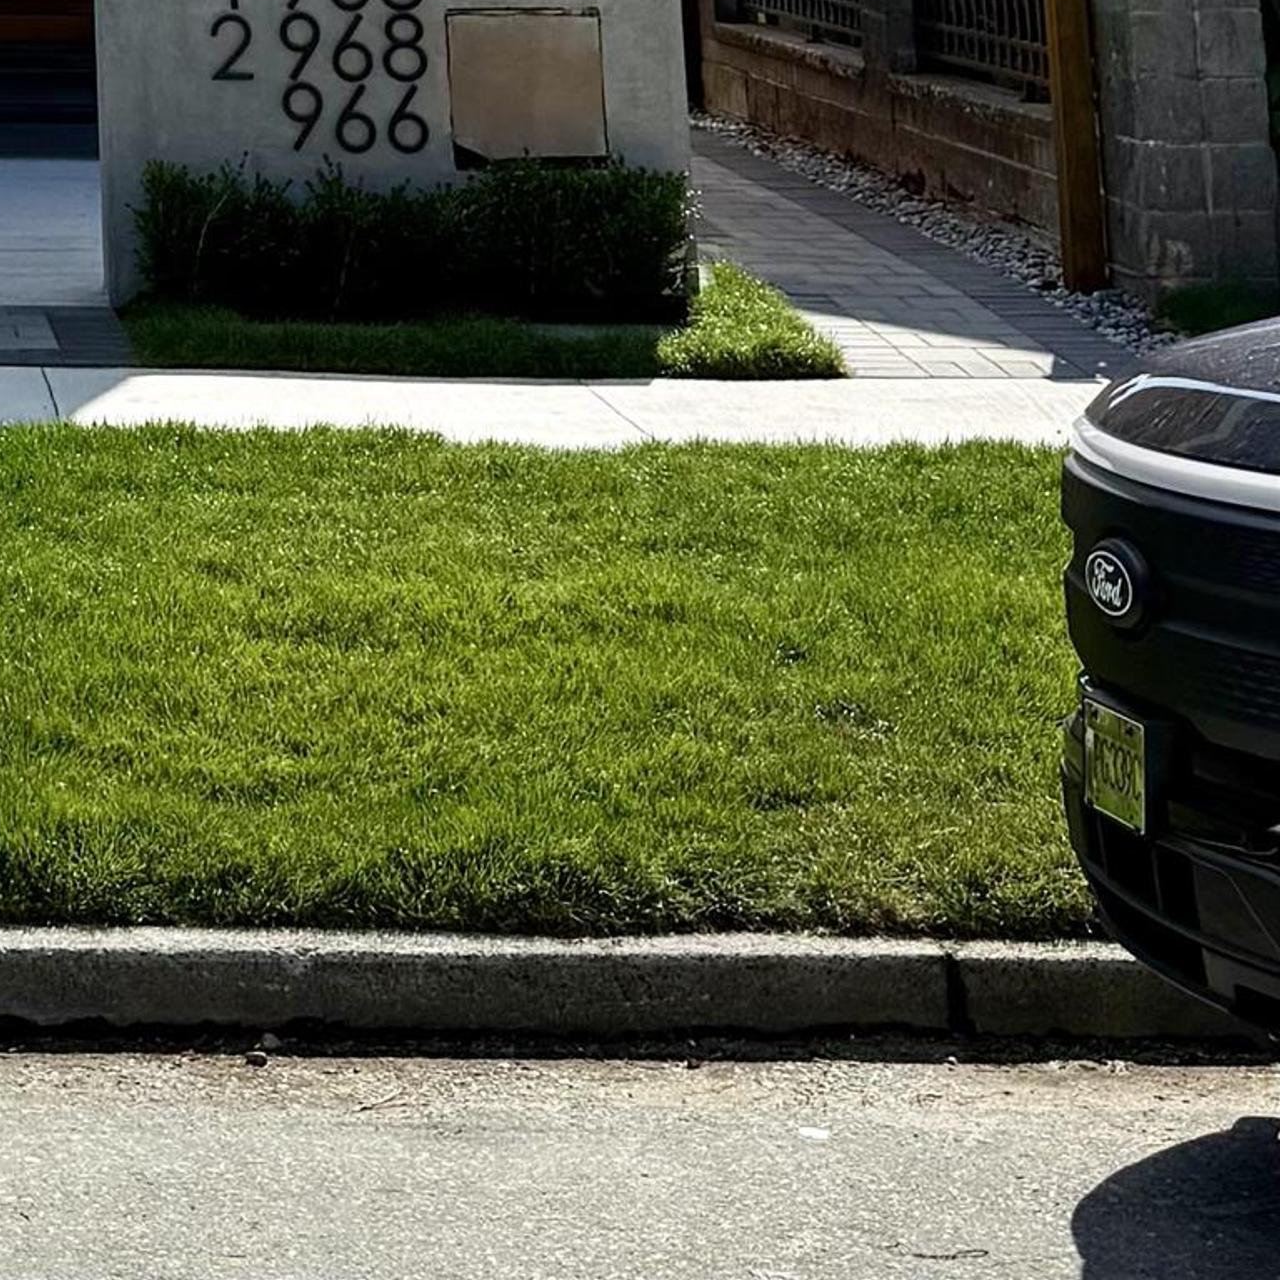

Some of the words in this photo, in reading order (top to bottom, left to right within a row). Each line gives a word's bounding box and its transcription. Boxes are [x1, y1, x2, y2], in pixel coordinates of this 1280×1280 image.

[210, 13, 255, 81] 2
[279, 11, 428, 82] 968
[281, 81, 429, 154] 966
[1092, 558, 1123, 608] Ford
